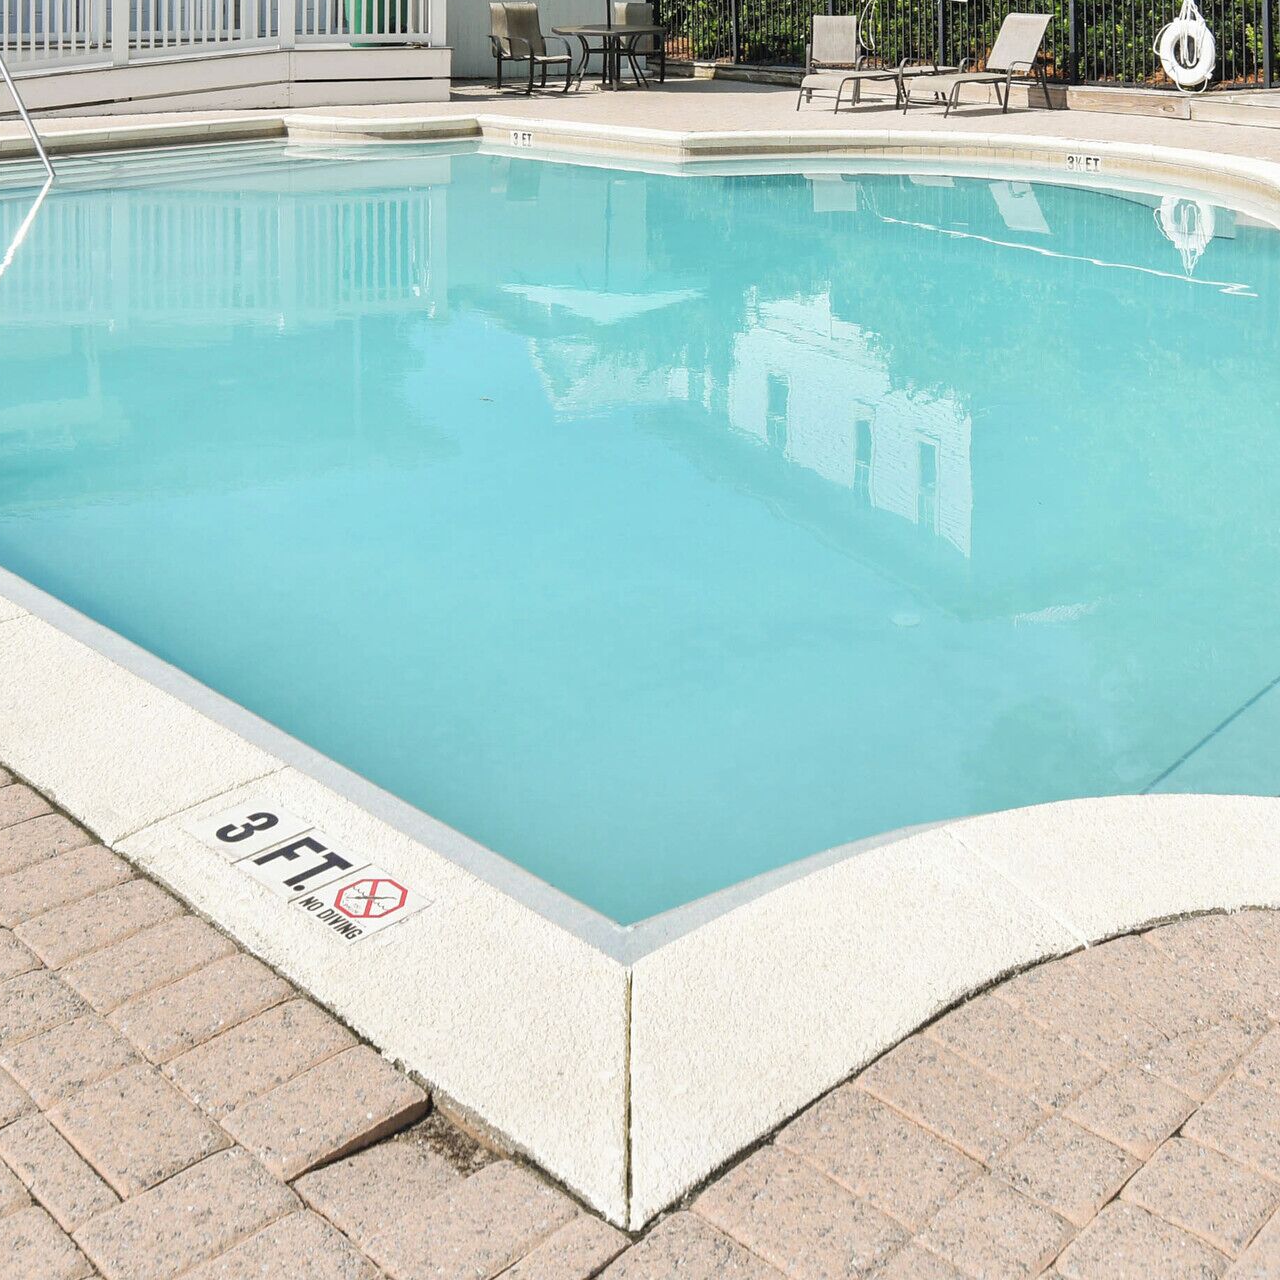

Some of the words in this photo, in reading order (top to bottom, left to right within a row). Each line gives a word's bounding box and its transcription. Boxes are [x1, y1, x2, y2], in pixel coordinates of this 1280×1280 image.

[215, 812, 279, 843] 3
[252, 836, 354, 892] FT.
[298, 896, 325, 911] NO
[316, 908, 363, 940] DIVING
